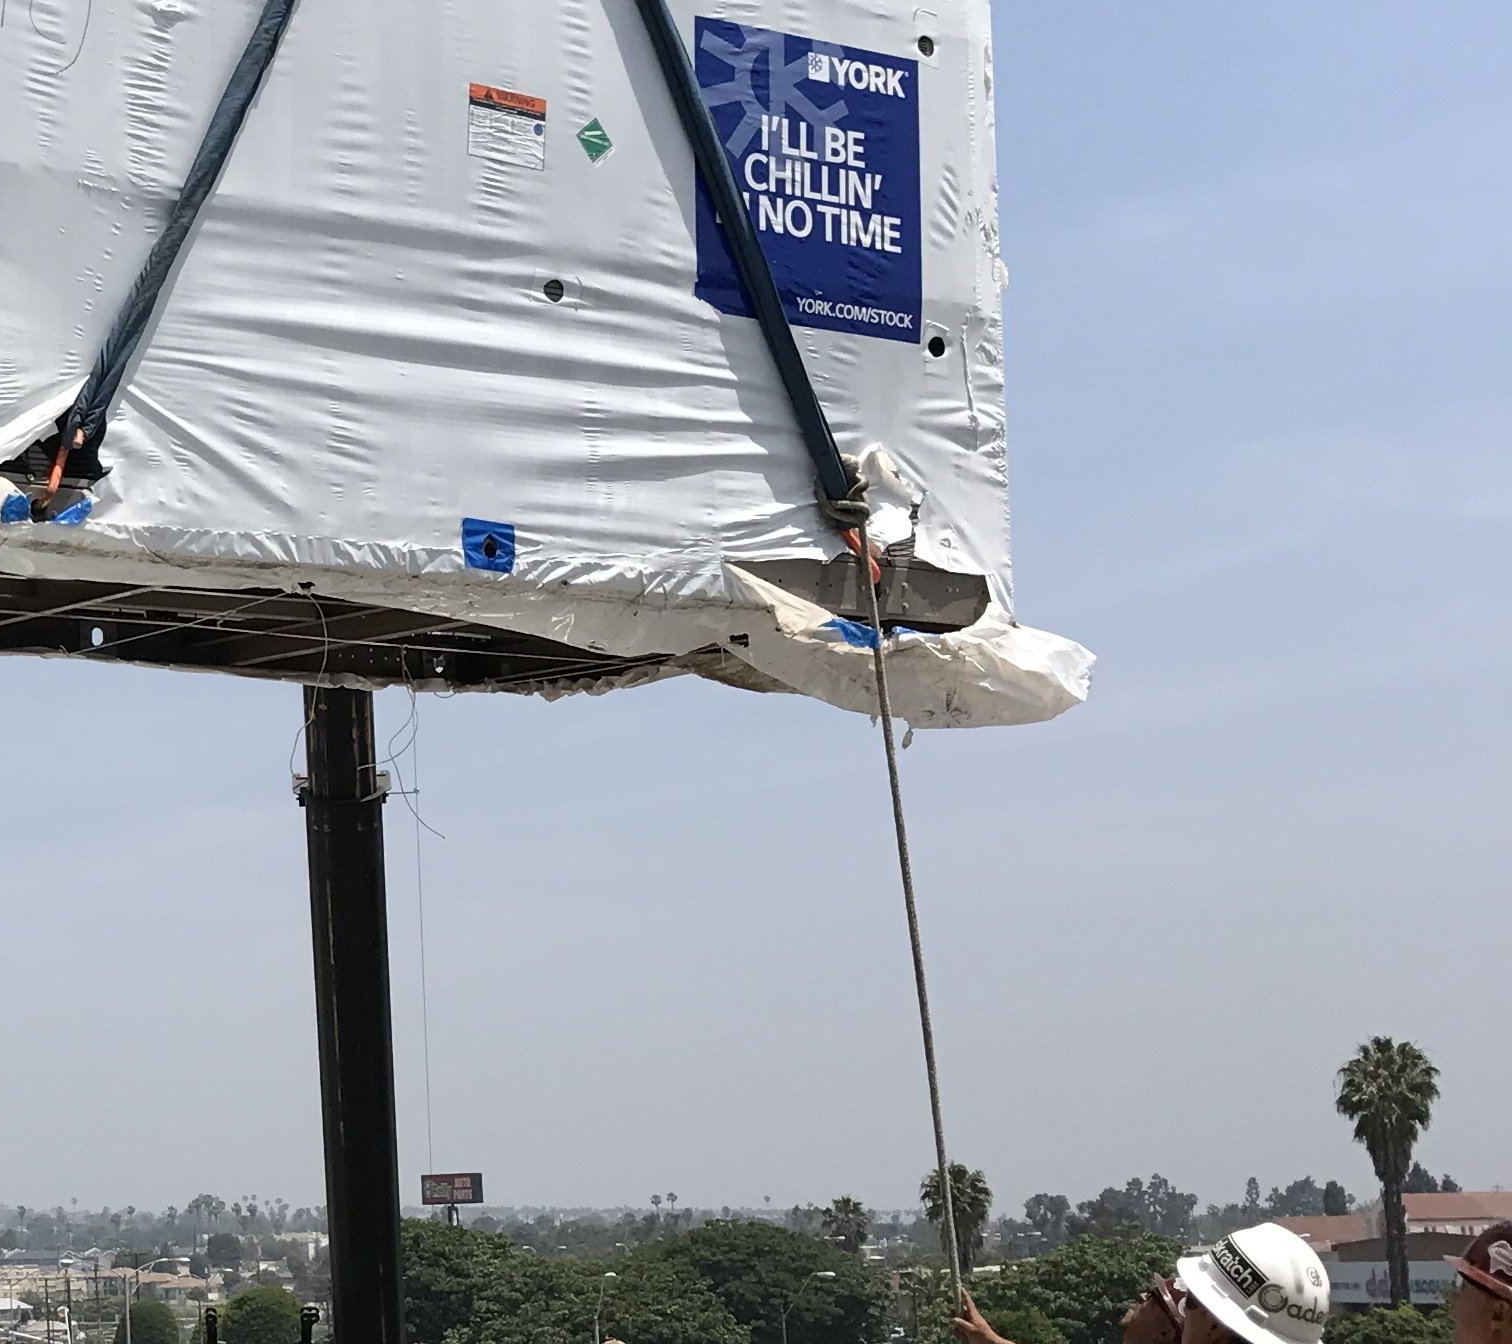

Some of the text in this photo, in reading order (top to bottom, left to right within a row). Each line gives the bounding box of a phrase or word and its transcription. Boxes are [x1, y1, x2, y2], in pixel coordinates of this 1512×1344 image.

[829, 56, 907, 99] YORK
[761, 114, 866, 169] I'LL BE
[744, 152, 883, 209] CHILLIN'
[758, 194, 813, 238] NO
[816, 203, 902, 254] TIME
[796, 296, 914, 329] YORK.COM/STOCK
